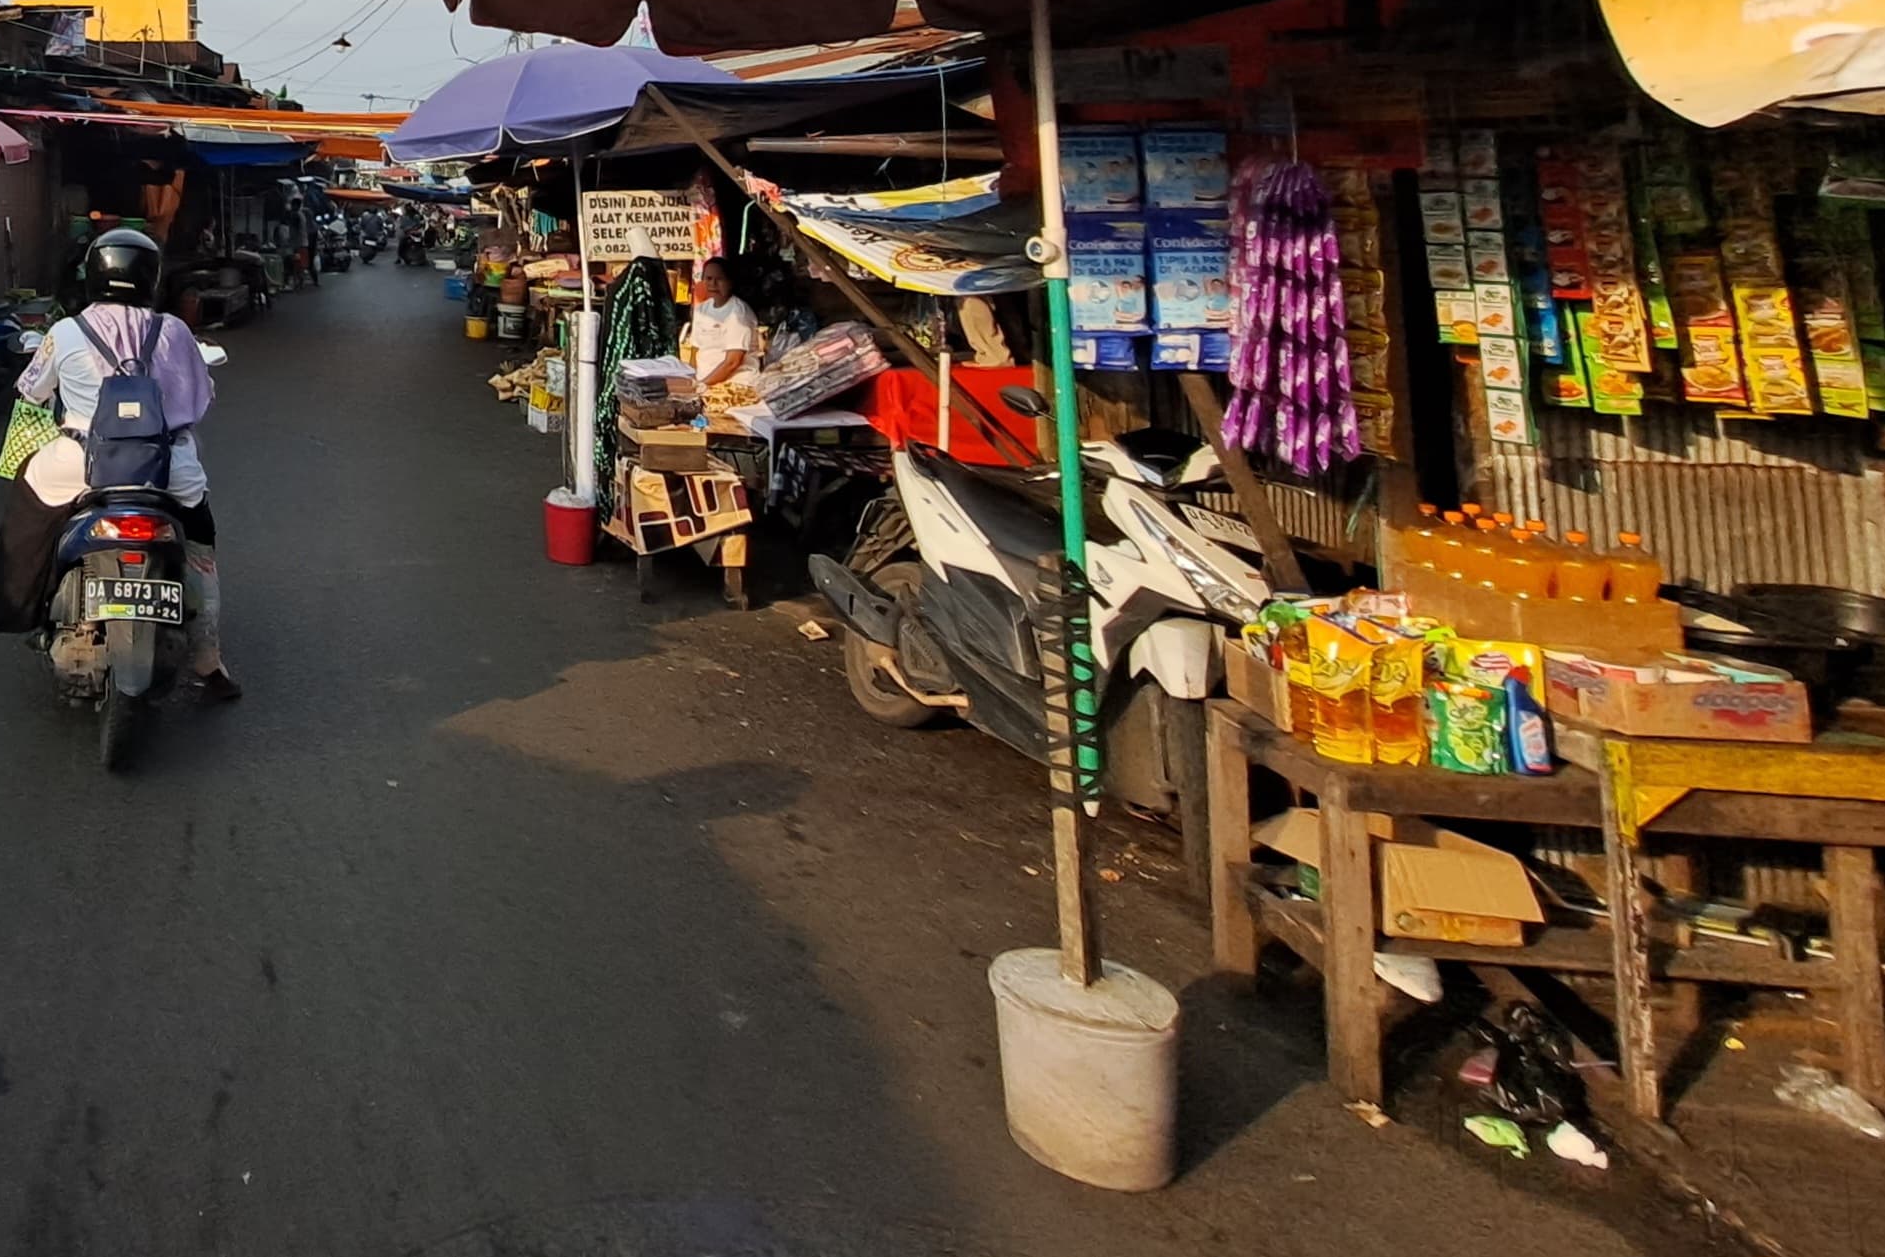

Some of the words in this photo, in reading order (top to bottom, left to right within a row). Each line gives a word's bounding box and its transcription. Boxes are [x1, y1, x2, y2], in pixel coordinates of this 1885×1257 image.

[589, 197, 626, 209] DISINI
[630, 197, 655, 208] ADA
[657, 196, 691, 207] JUAL
[592, 212, 622, 224] ALAT
[626, 211, 690, 223] KEMATIAN
[88, 581, 105, 598] DA
[114, 582, 152, 599] 6873
[161, 585, 179, 603] MS
